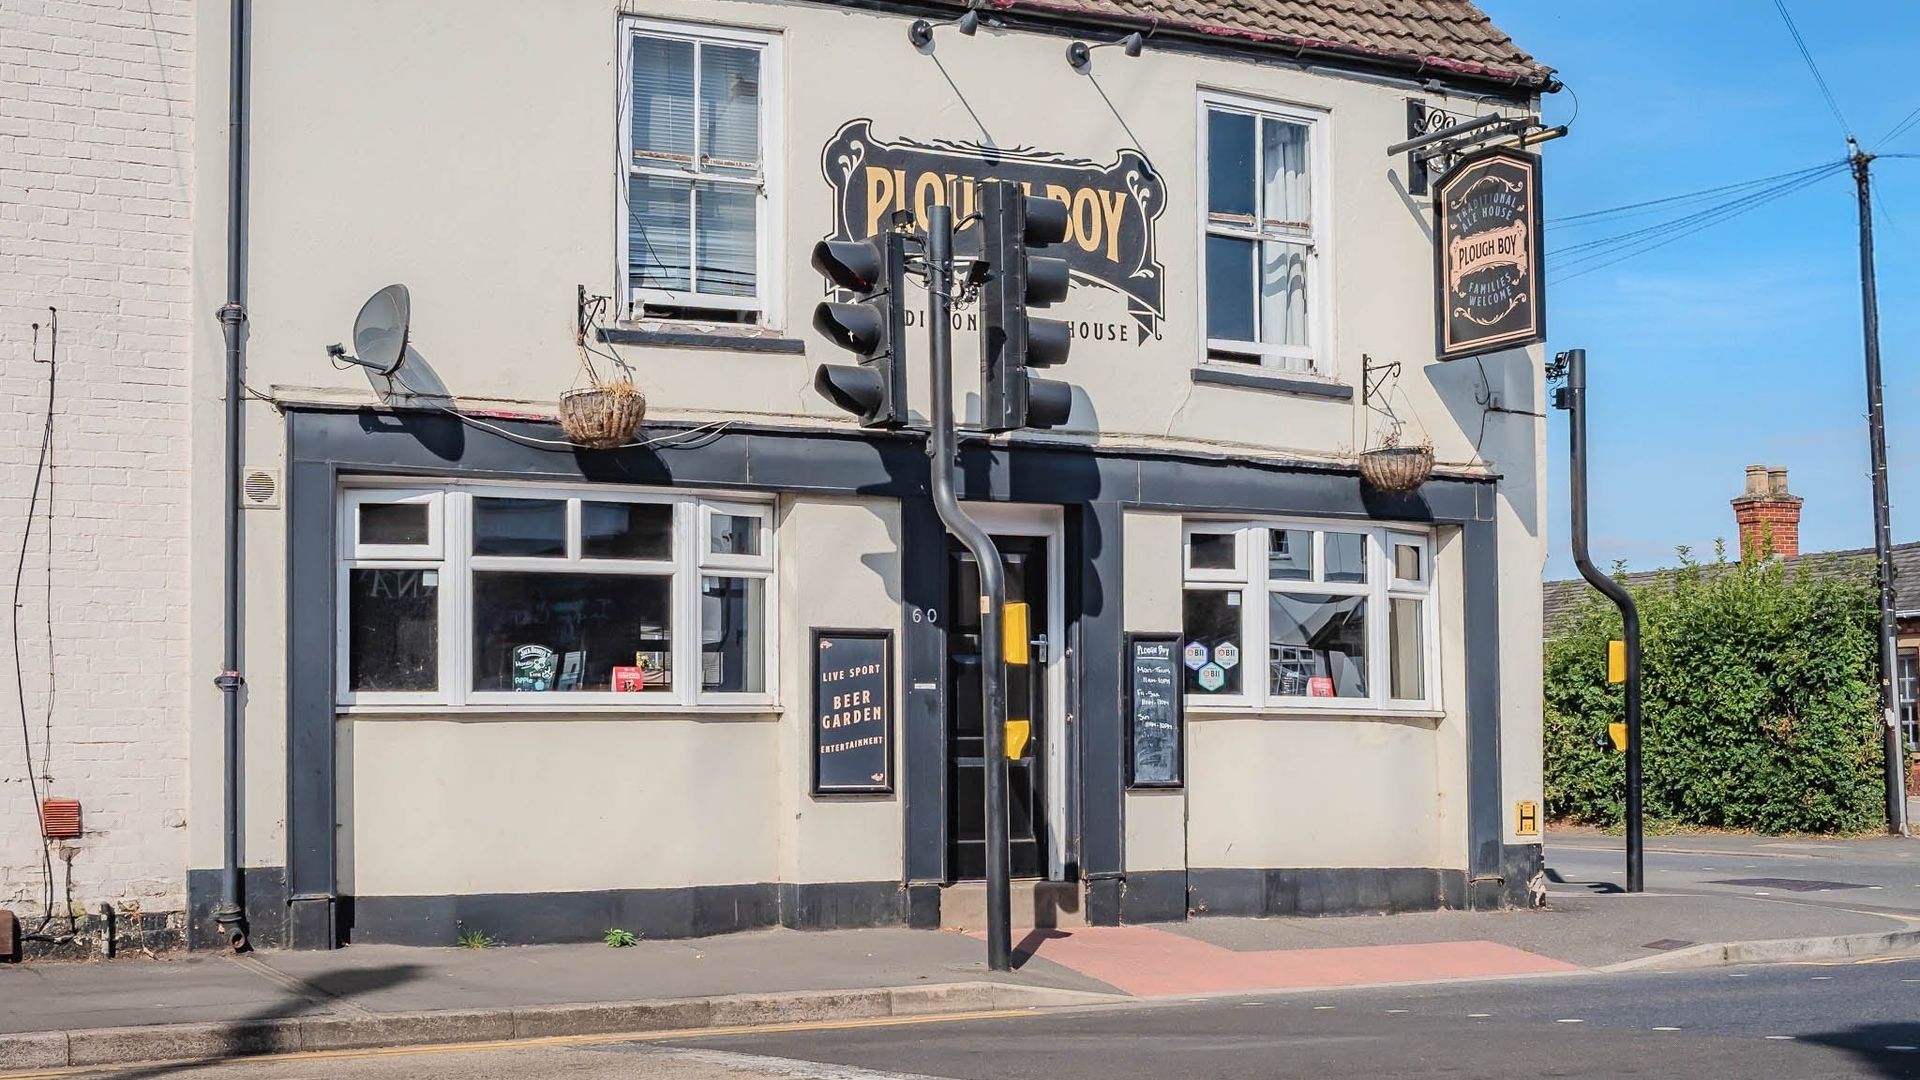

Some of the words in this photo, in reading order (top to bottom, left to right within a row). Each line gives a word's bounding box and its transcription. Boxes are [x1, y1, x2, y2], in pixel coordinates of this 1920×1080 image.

[865, 166, 1031, 241] PLOU
[1046, 184, 1128, 263] BOY
[1461, 213, 1478, 232] ALE
[1482, 205, 1513, 221] HOUSE
[1459, 240, 1495, 269] PLOUGH
[1498, 233, 1517, 256] BOY
[1468, 272, 1512, 292] FAMILIES
[1469, 286, 1513, 307] WELCOME
[822, 670, 845, 682] LIVE
[850, 664, 881, 678] SPORT
[833, 690, 871, 710] BEER
[822, 706, 881, 729] GARDEN
[820, 736, 884, 754] ENTERTAINMENT
[1520, 804, 1535, 831] H
